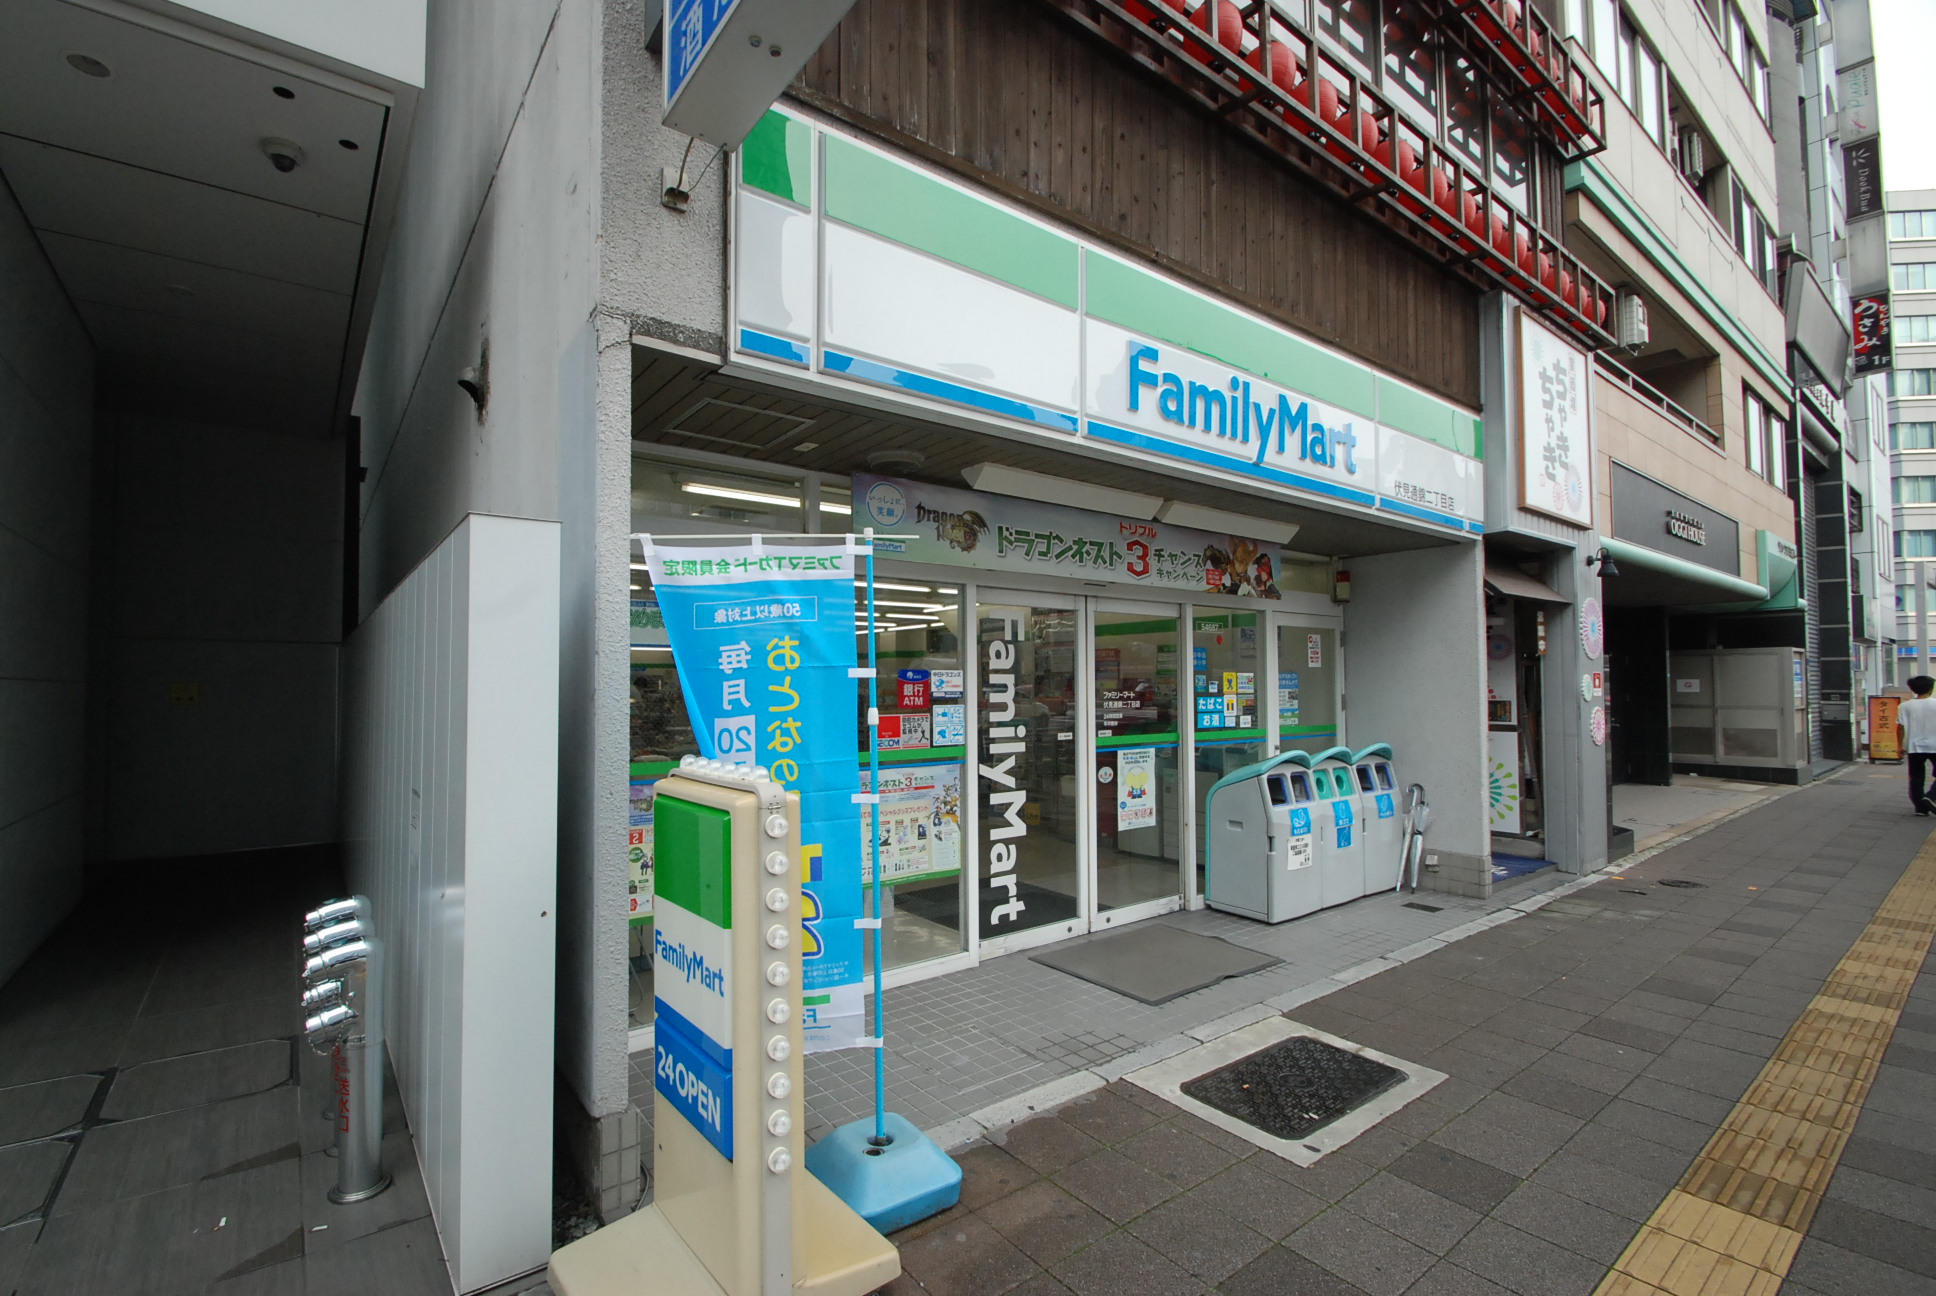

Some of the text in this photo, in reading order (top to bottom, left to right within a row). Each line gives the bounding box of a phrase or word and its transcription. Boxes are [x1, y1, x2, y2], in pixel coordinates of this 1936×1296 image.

[1128, 340, 1358, 475] FamilyMart
[873, 541, 903, 551] amilyMart
[997, 524, 1123, 568] ドラゴンネスト
[1126, 539, 1150, 577] 3
[1153, 547, 1204, 569] チャンス
[1201, 622, 1220, 632] 54687
[903, 684, 924, 696] 銀行
[1103, 691, 1136, 700] ファミリーマート
[903, 697, 924, 706] ATM
[1199, 698, 1224, 710] たばこ
[1203, 714, 1220, 726] お酒
[878, 739, 900, 748] ECOM
[979, 609, 1026, 925] FamilyMart
[861, 779, 904, 790] ランネスト
[655, 928, 725, 998] FamilyMart
